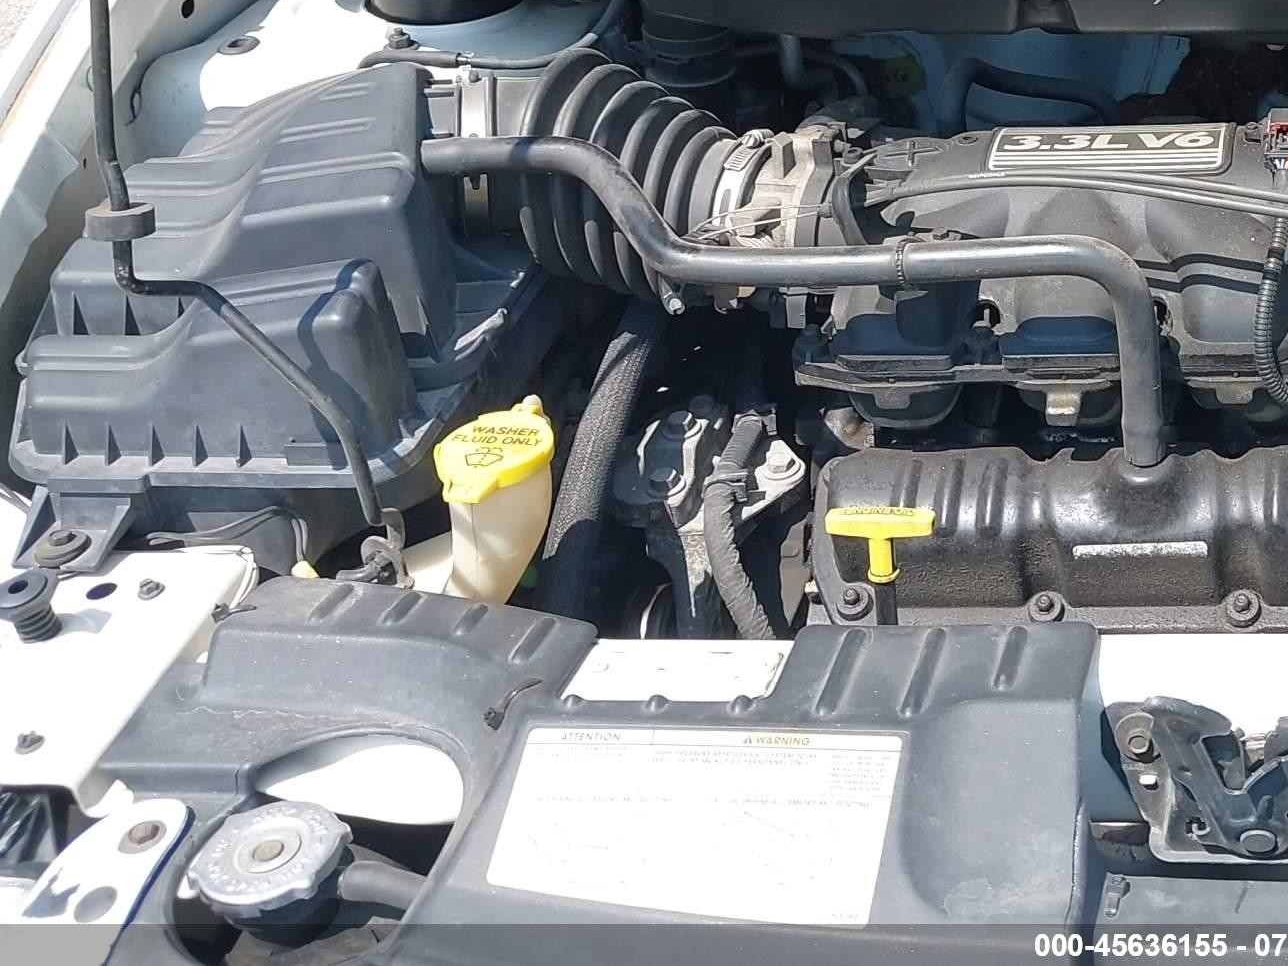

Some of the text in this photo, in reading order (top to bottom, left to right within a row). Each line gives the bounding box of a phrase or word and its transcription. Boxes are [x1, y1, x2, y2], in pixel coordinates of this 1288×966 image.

[1003, 131, 1215, 150] 3.3L V6
[471, 425, 540, 436] WASHER
[451, 434, 543, 446] FLUID ONLY
[561, 732, 621, 742] ATTENTION
[755, 735, 811, 746] WARNING
